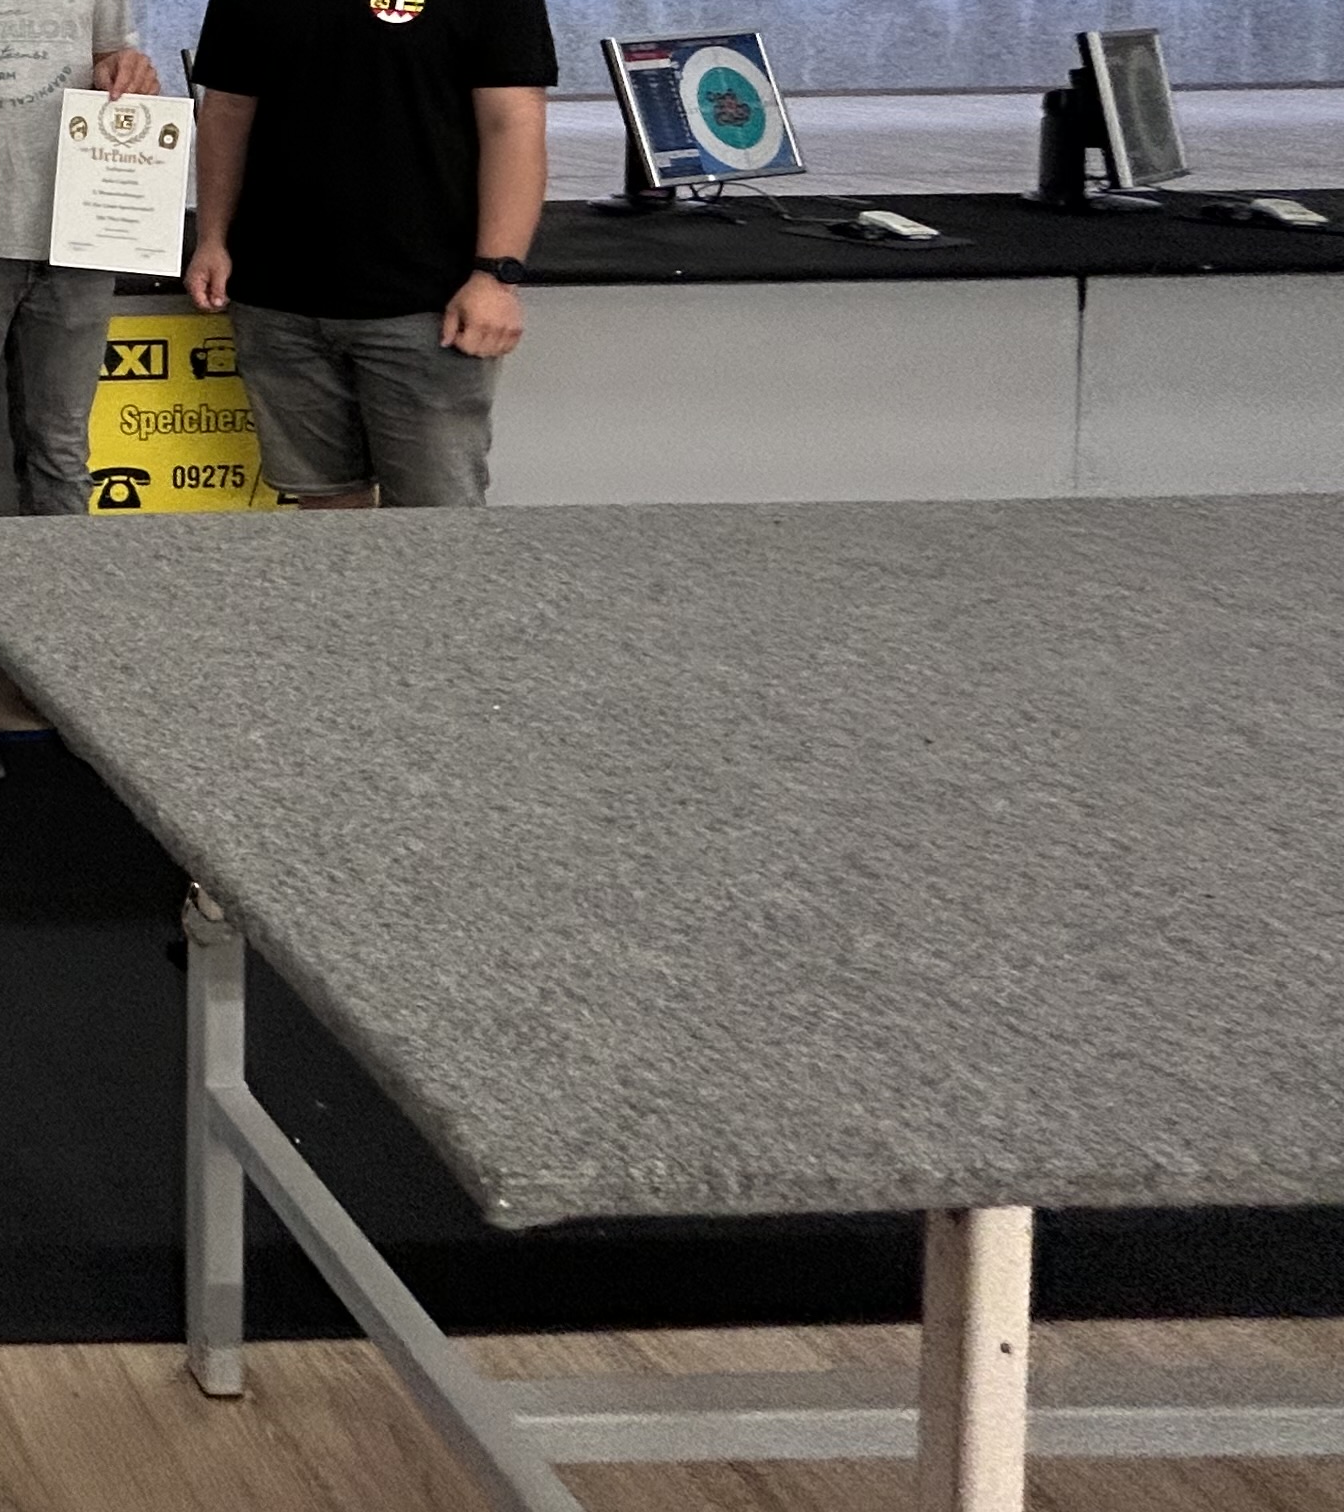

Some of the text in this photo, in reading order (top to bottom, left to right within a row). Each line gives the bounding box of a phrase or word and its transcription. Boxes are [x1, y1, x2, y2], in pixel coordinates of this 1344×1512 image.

[91, 147, 154, 165] Urkunde
[99, 344, 163, 376] XI
[172, 464, 245, 489] 09275
